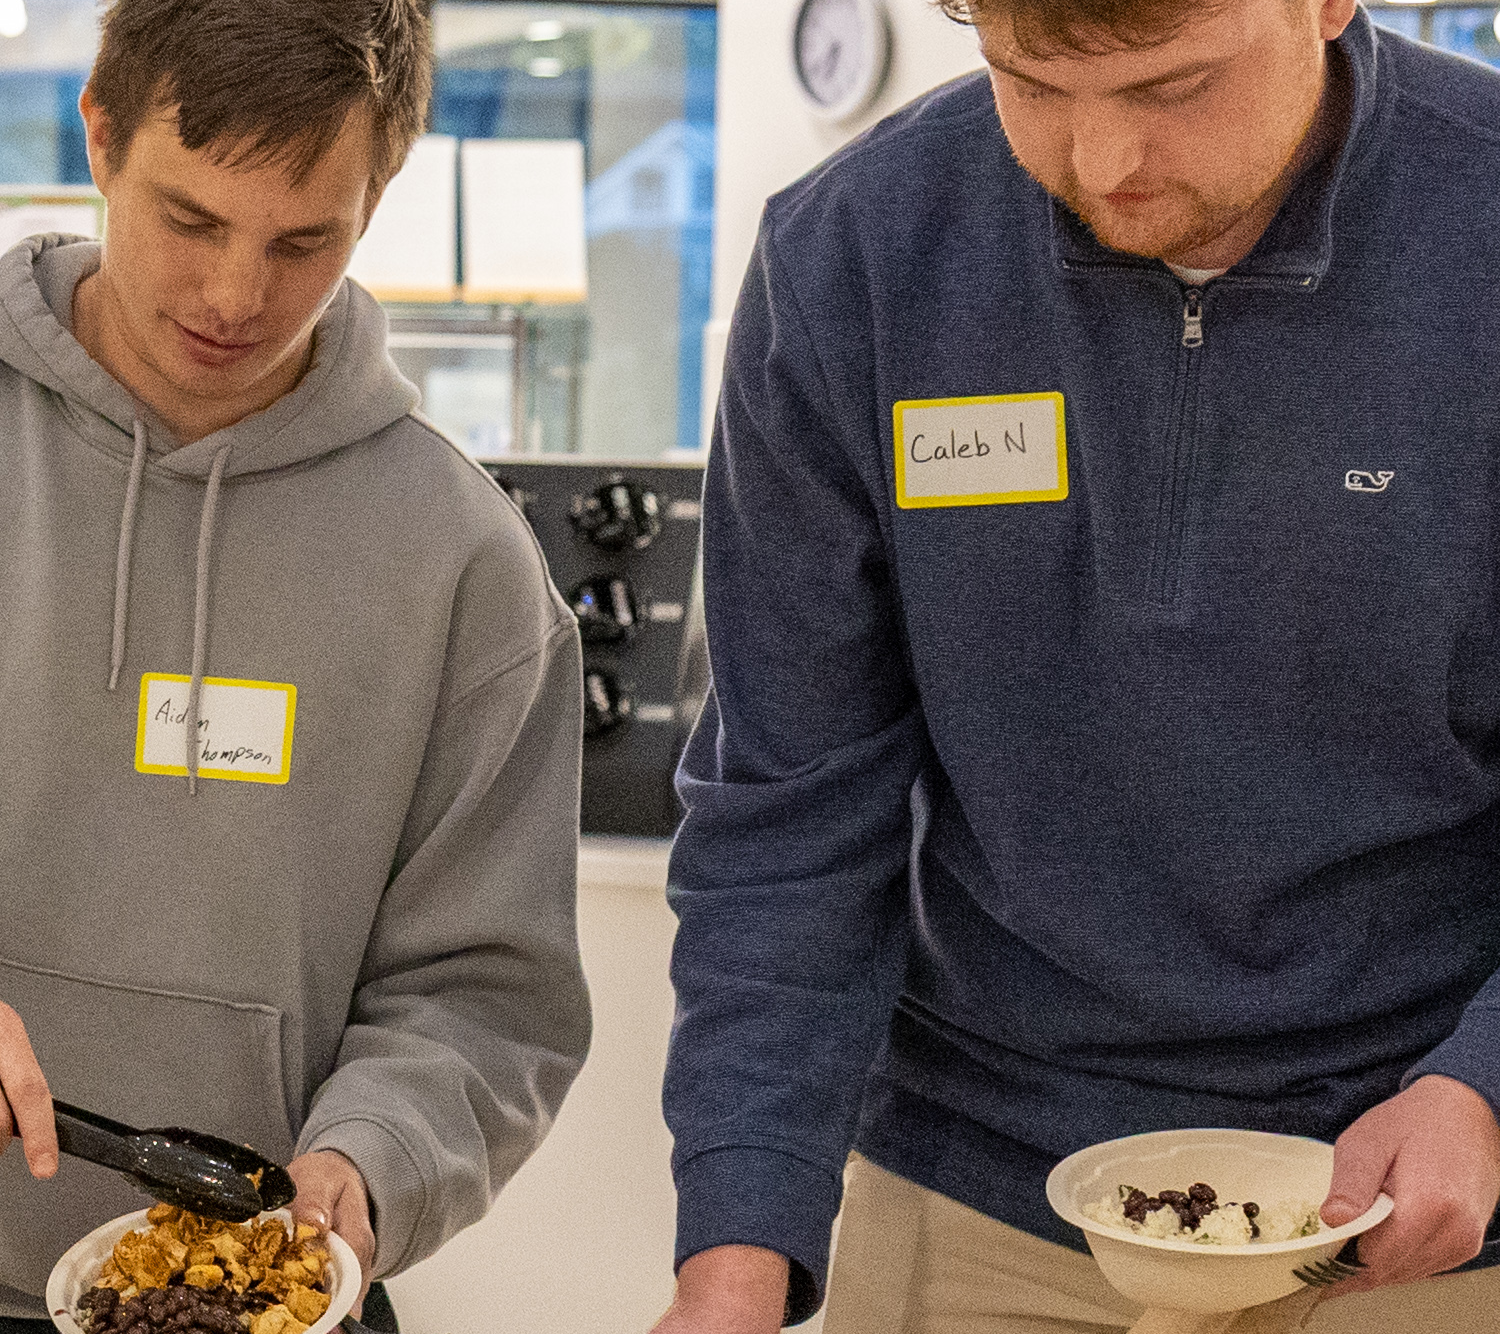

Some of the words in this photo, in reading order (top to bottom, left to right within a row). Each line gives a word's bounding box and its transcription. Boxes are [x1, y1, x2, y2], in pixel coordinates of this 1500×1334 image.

[911, 428, 990, 463] Caleb
[1003, 421, 1027, 454] N
[154, 698, 210, 732] Aidn
